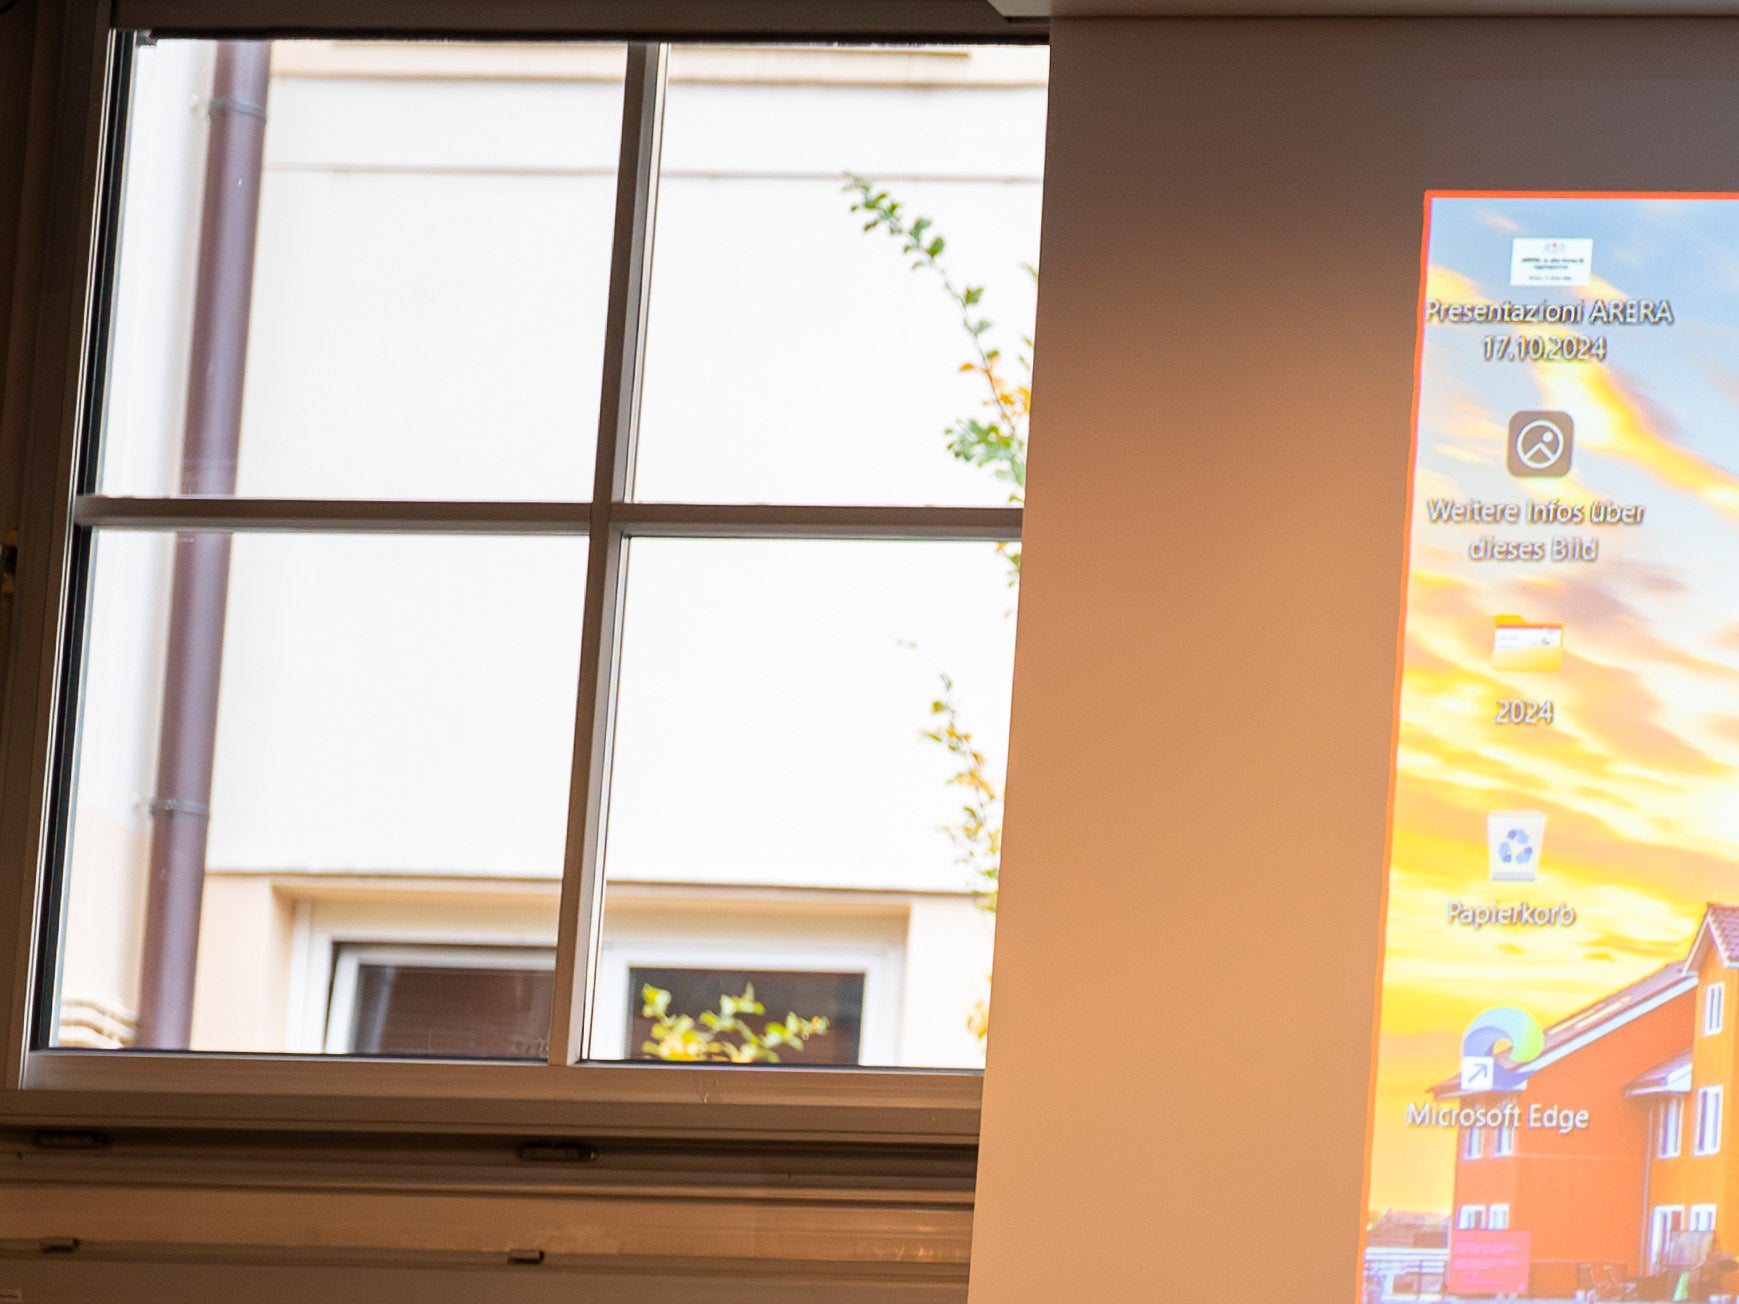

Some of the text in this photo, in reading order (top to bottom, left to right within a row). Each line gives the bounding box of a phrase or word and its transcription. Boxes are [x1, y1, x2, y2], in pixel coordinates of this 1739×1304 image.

[1592, 301, 1673, 325] ARERA
[1481, 336, 1606, 360] 17.10.2024
[1496, 701, 1553, 724] 2024
[1447, 902, 1575, 929] Papierkorb
[1406, 1104, 1589, 1130] Microsoft Edge
